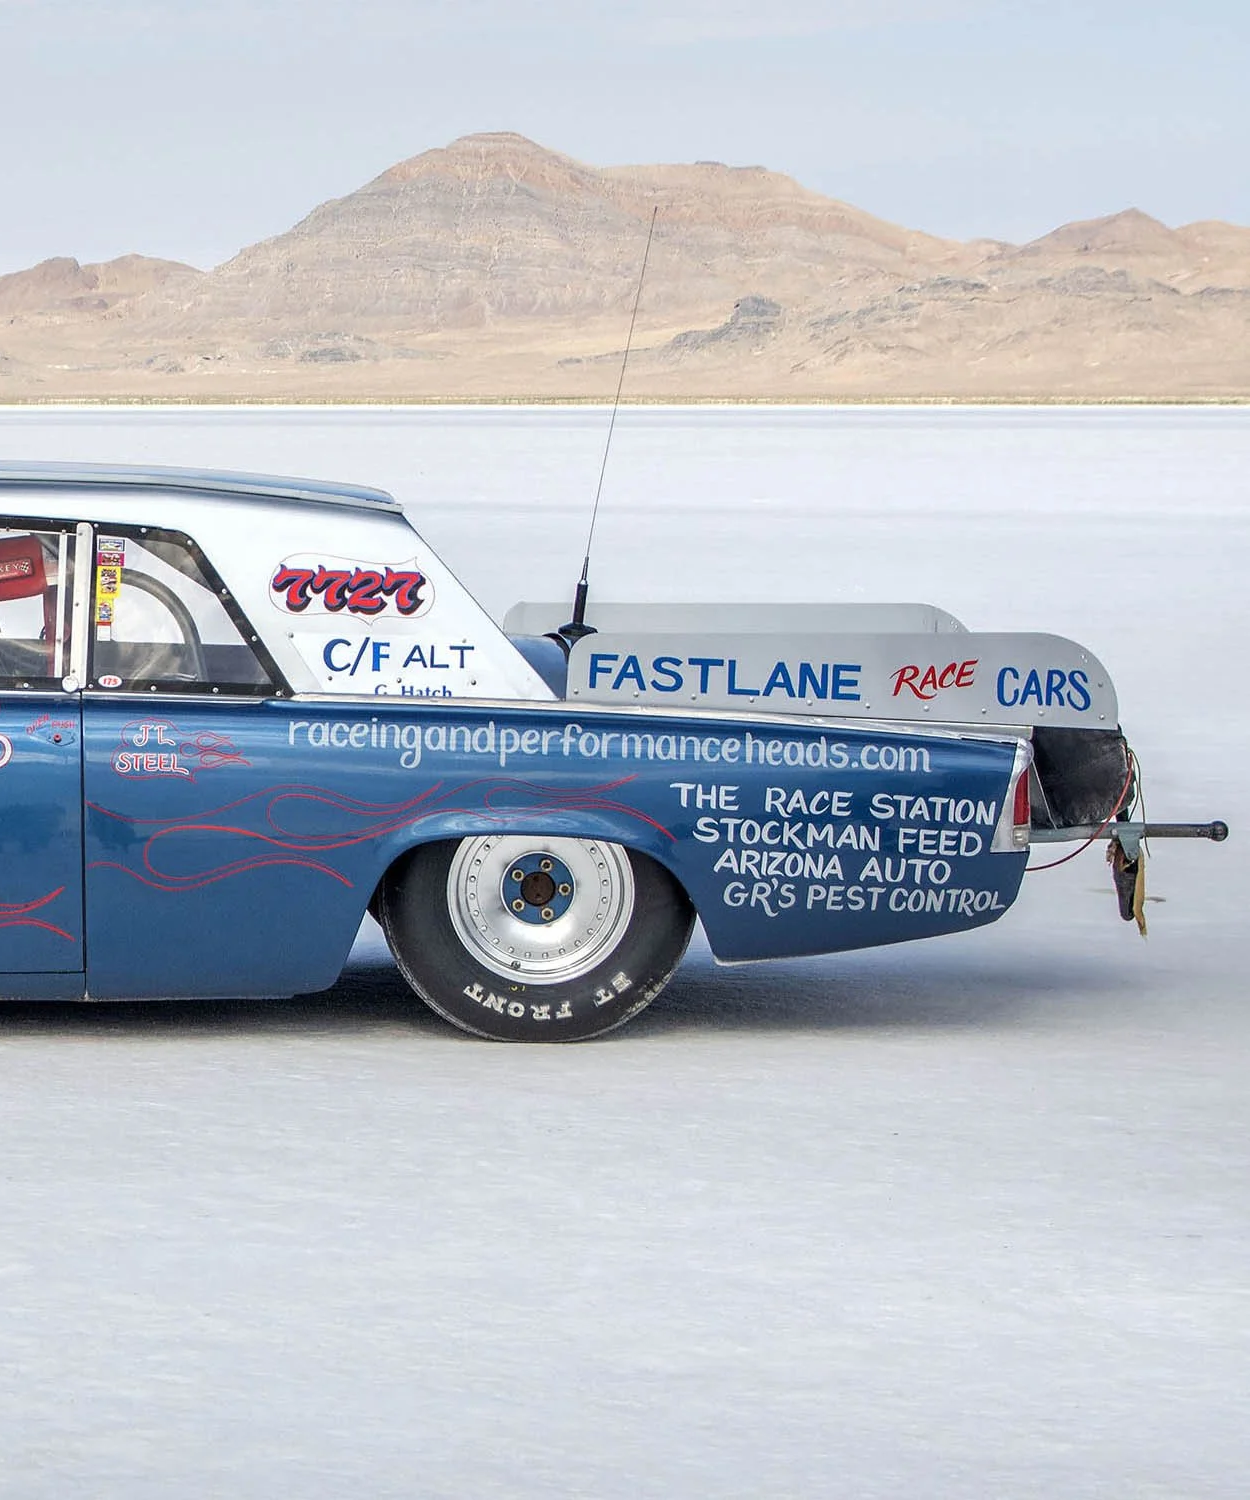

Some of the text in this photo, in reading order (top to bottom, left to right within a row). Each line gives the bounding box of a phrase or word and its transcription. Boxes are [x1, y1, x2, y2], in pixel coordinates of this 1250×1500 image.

[272, 564, 426, 615] 7727
[323, 637, 475, 676] C/F ALT
[401, 685, 452, 698] Hatch
[588, 653, 1091, 711] FASTLANE RACE CARS
[115, 752, 189, 775] STEEL
[288, 718, 932, 773] raceingandperformanceheads.com
[670, 783, 996, 825] THE RACE STATION
[692, 817, 982, 856] STOCKMAN FEED
[713, 849, 951, 884] ARIZONA AUTO
[723, 878, 1005, 917] GR'S PEST CONTROL
[463, 971, 633, 1020] ET FRONT
